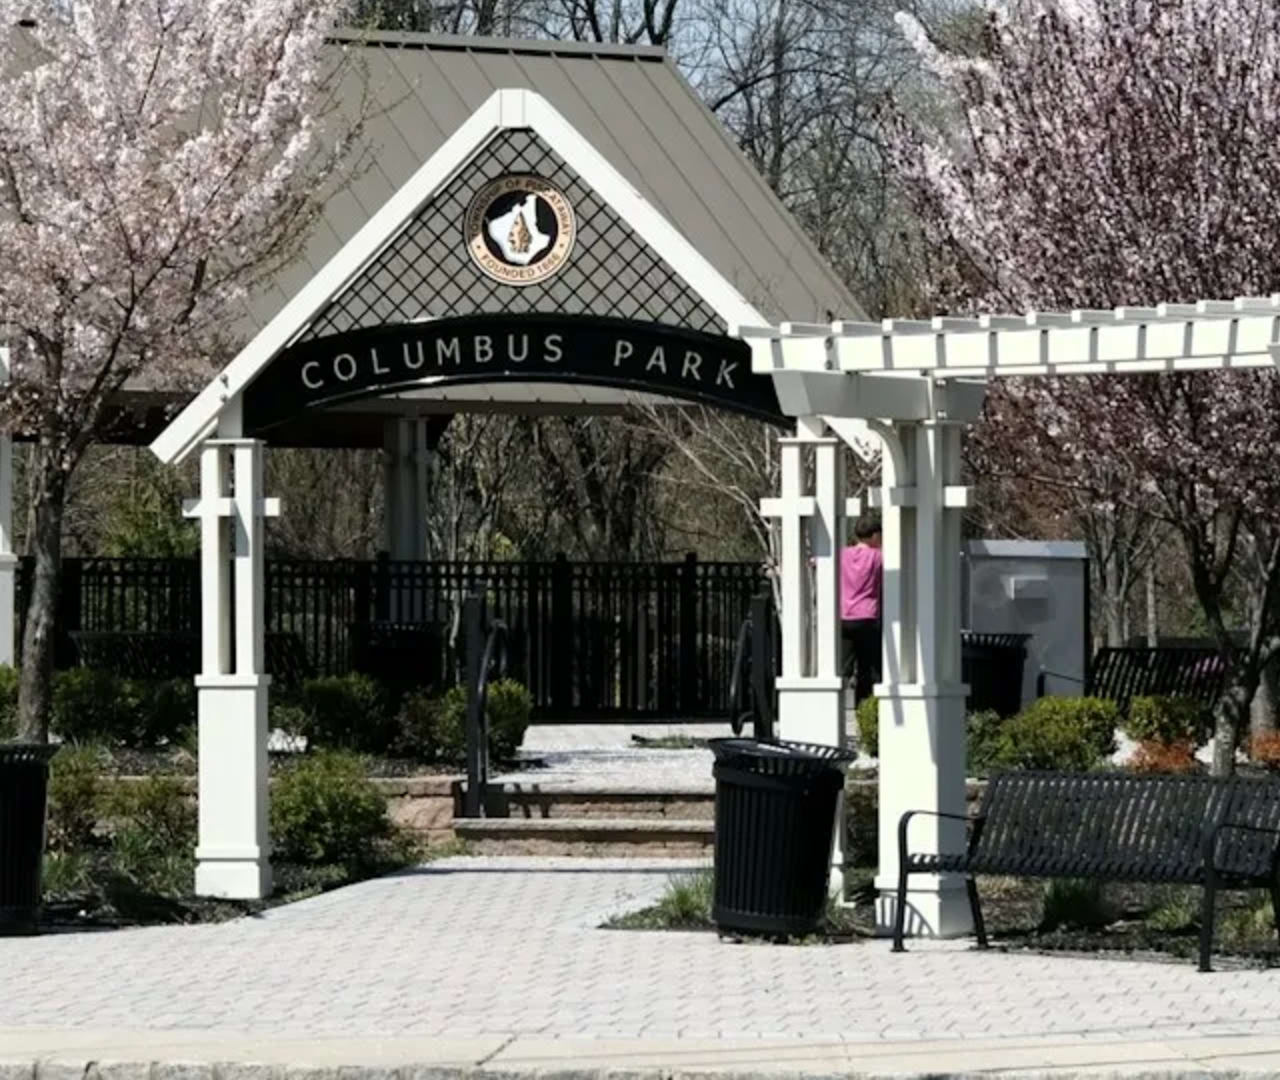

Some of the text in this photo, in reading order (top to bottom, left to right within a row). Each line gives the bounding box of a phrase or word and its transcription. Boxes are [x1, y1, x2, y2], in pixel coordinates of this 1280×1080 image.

[505, 180, 520, 189] OF
[481, 254, 535, 278] FOUNDED
[301, 334, 738, 389] COLUMBUS PARK
